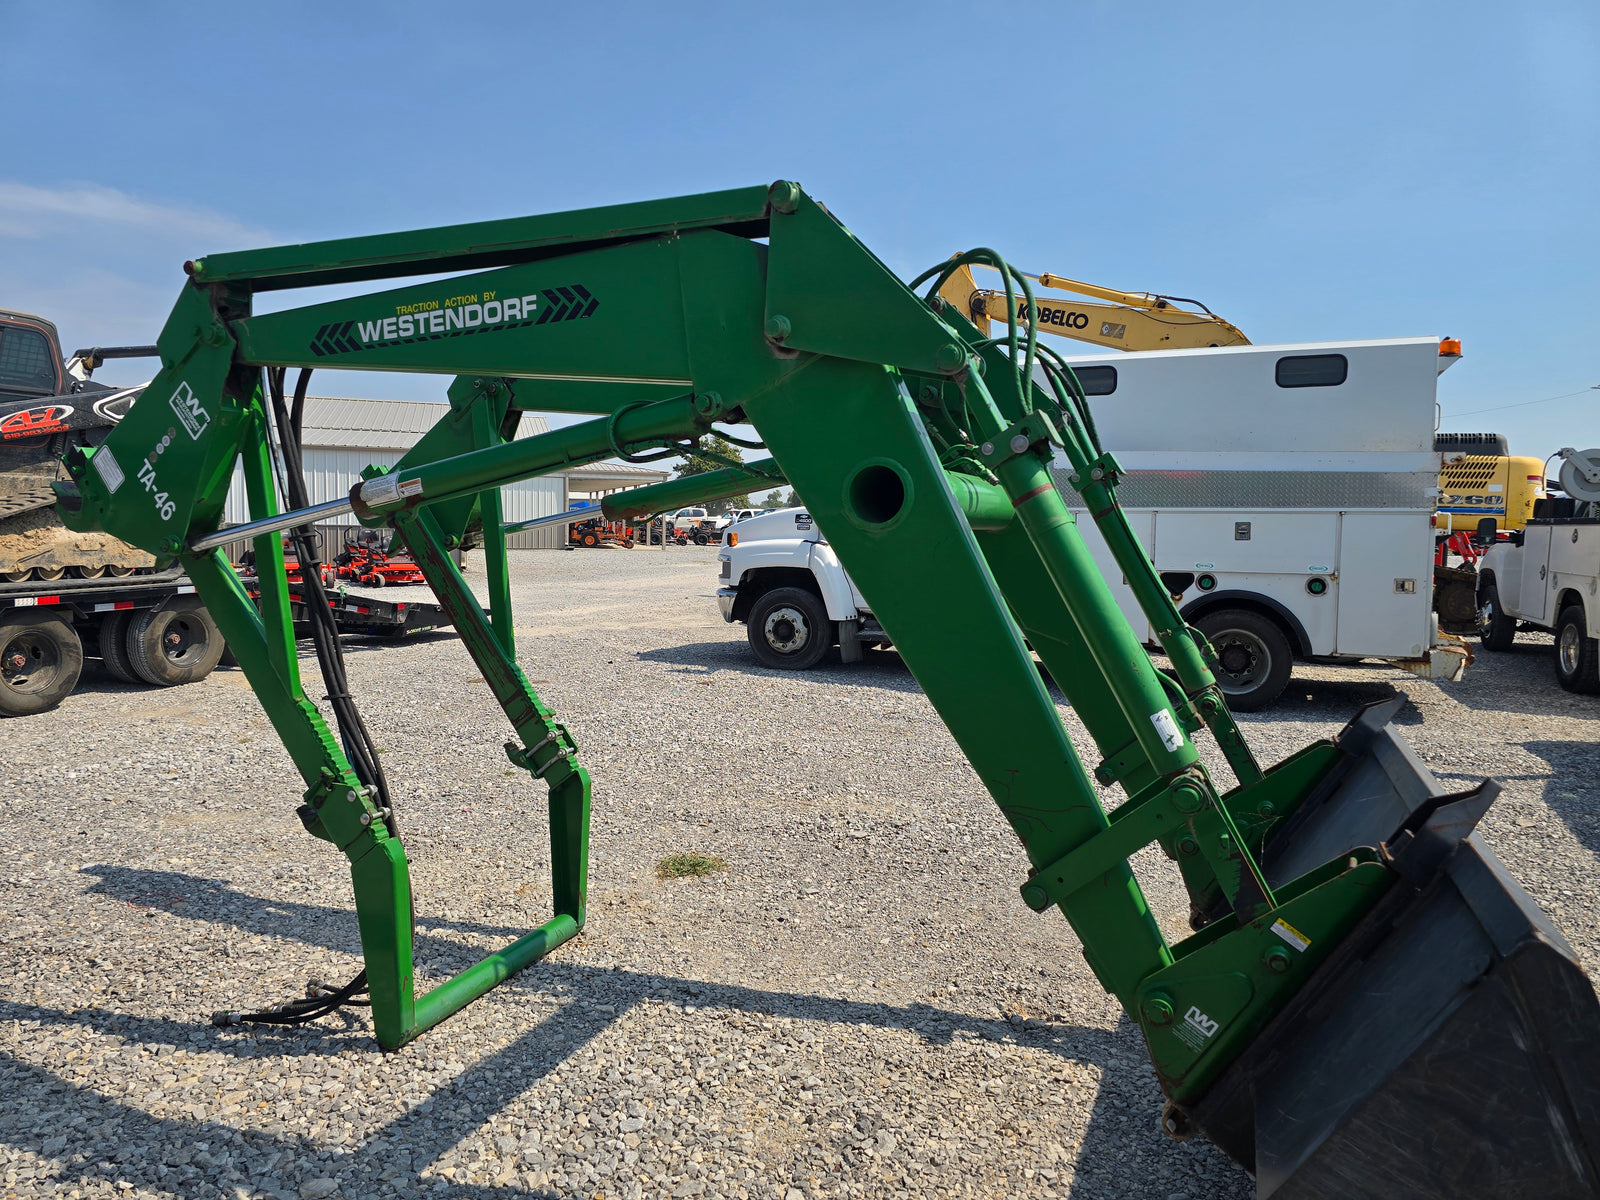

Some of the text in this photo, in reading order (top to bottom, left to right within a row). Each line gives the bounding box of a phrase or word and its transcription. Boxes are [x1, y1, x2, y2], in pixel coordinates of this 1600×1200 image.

[357, 294, 537, 343] WESTENDORF
[396, 291, 496, 315] TRACTION ACTION BY
[136, 457, 177, 521] TA-46
